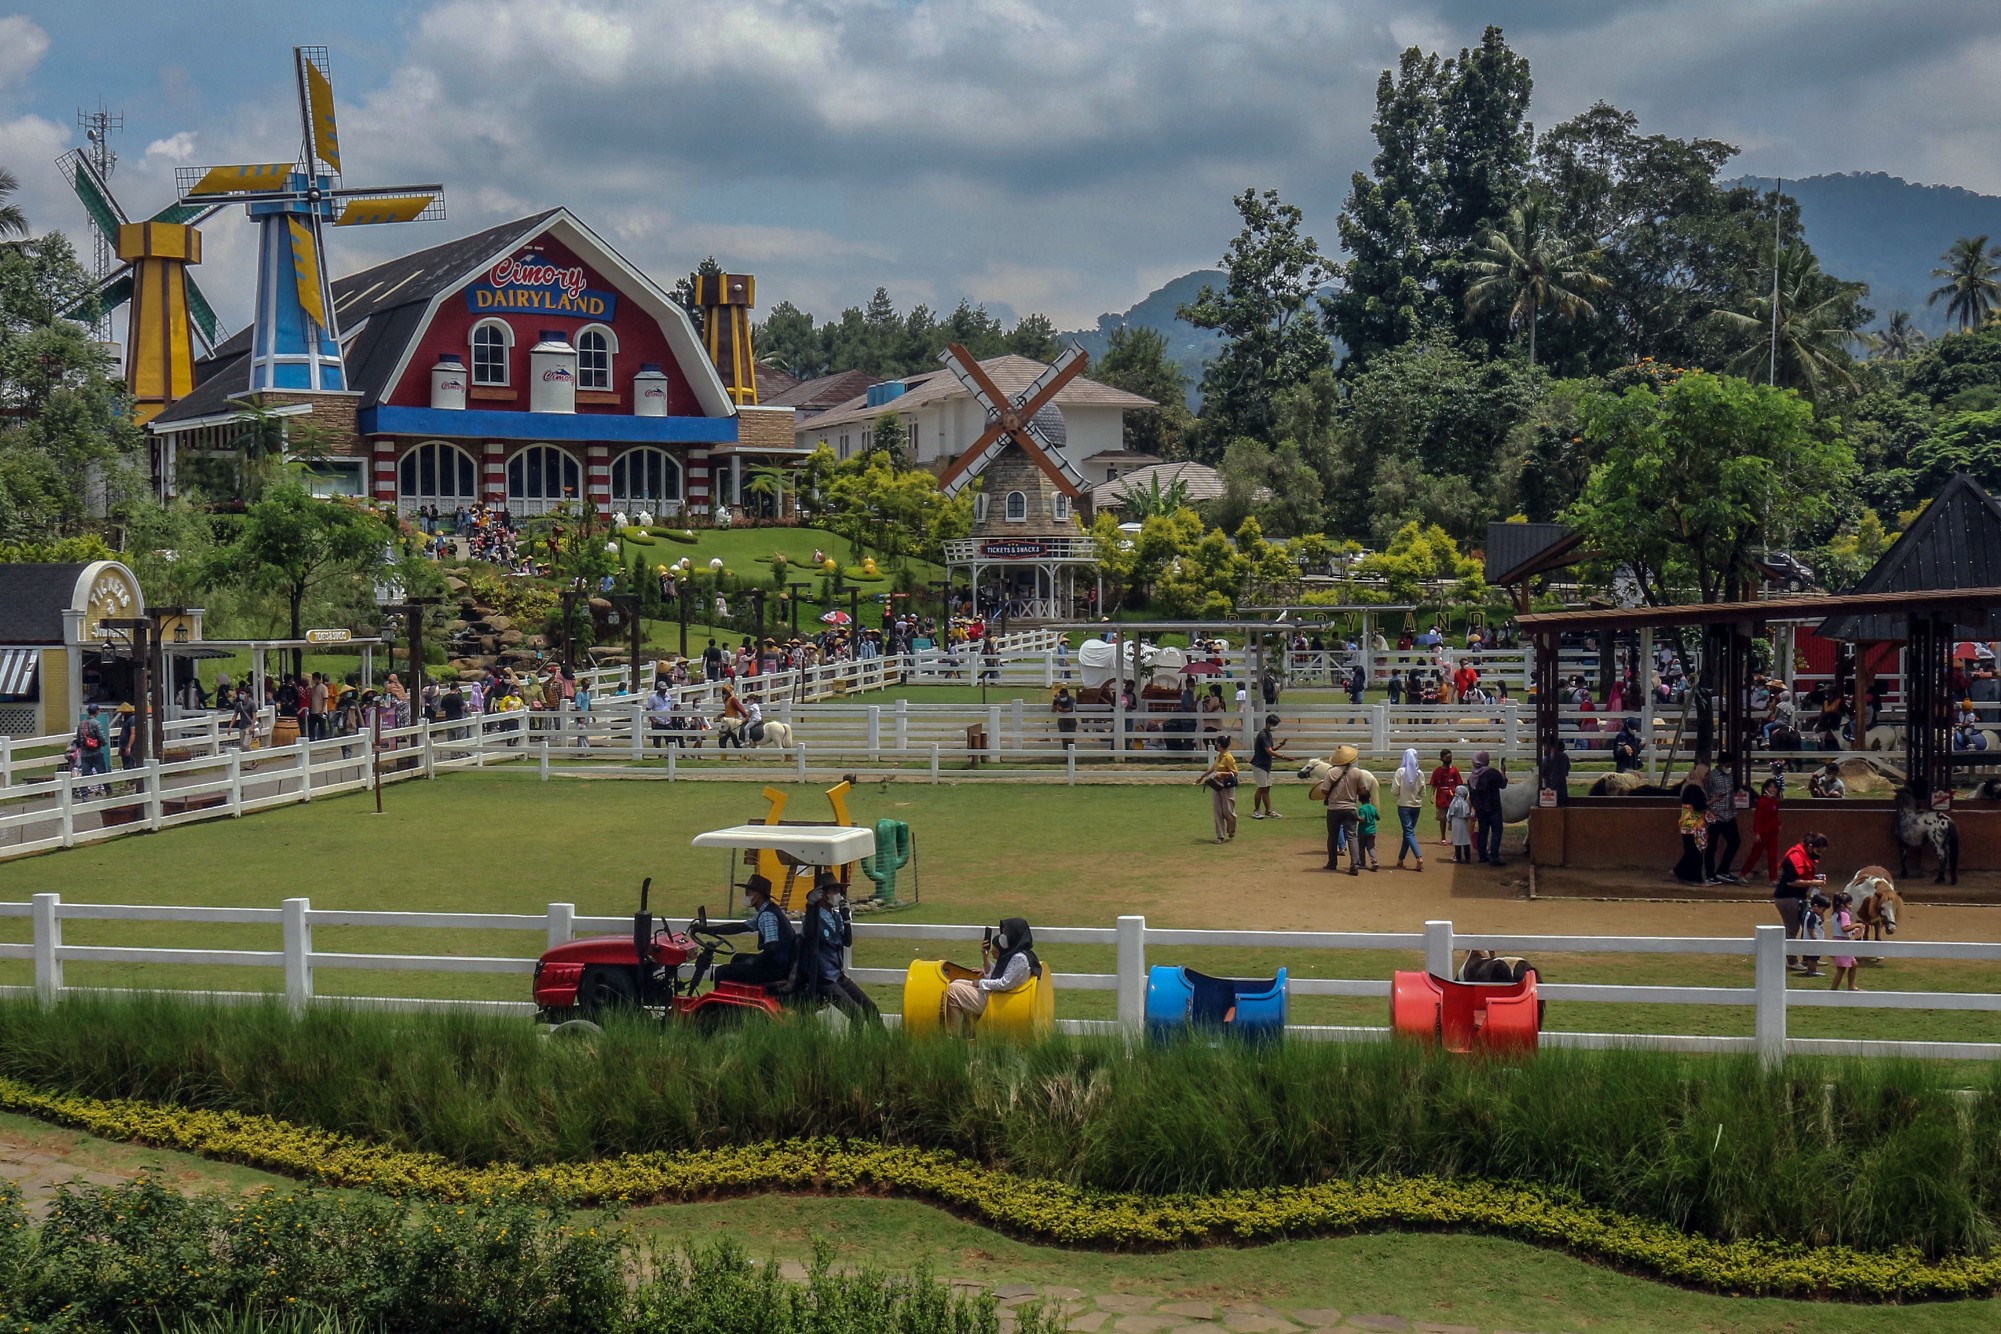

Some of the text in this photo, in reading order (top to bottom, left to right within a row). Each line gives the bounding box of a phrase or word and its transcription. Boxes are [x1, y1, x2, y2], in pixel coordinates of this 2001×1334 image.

[490, 257, 587, 299] Cimory
[476, 289, 605, 315] DAIRYLAND
[90, 578, 131, 607] TICKETS
[106, 598, 116, 616] &
